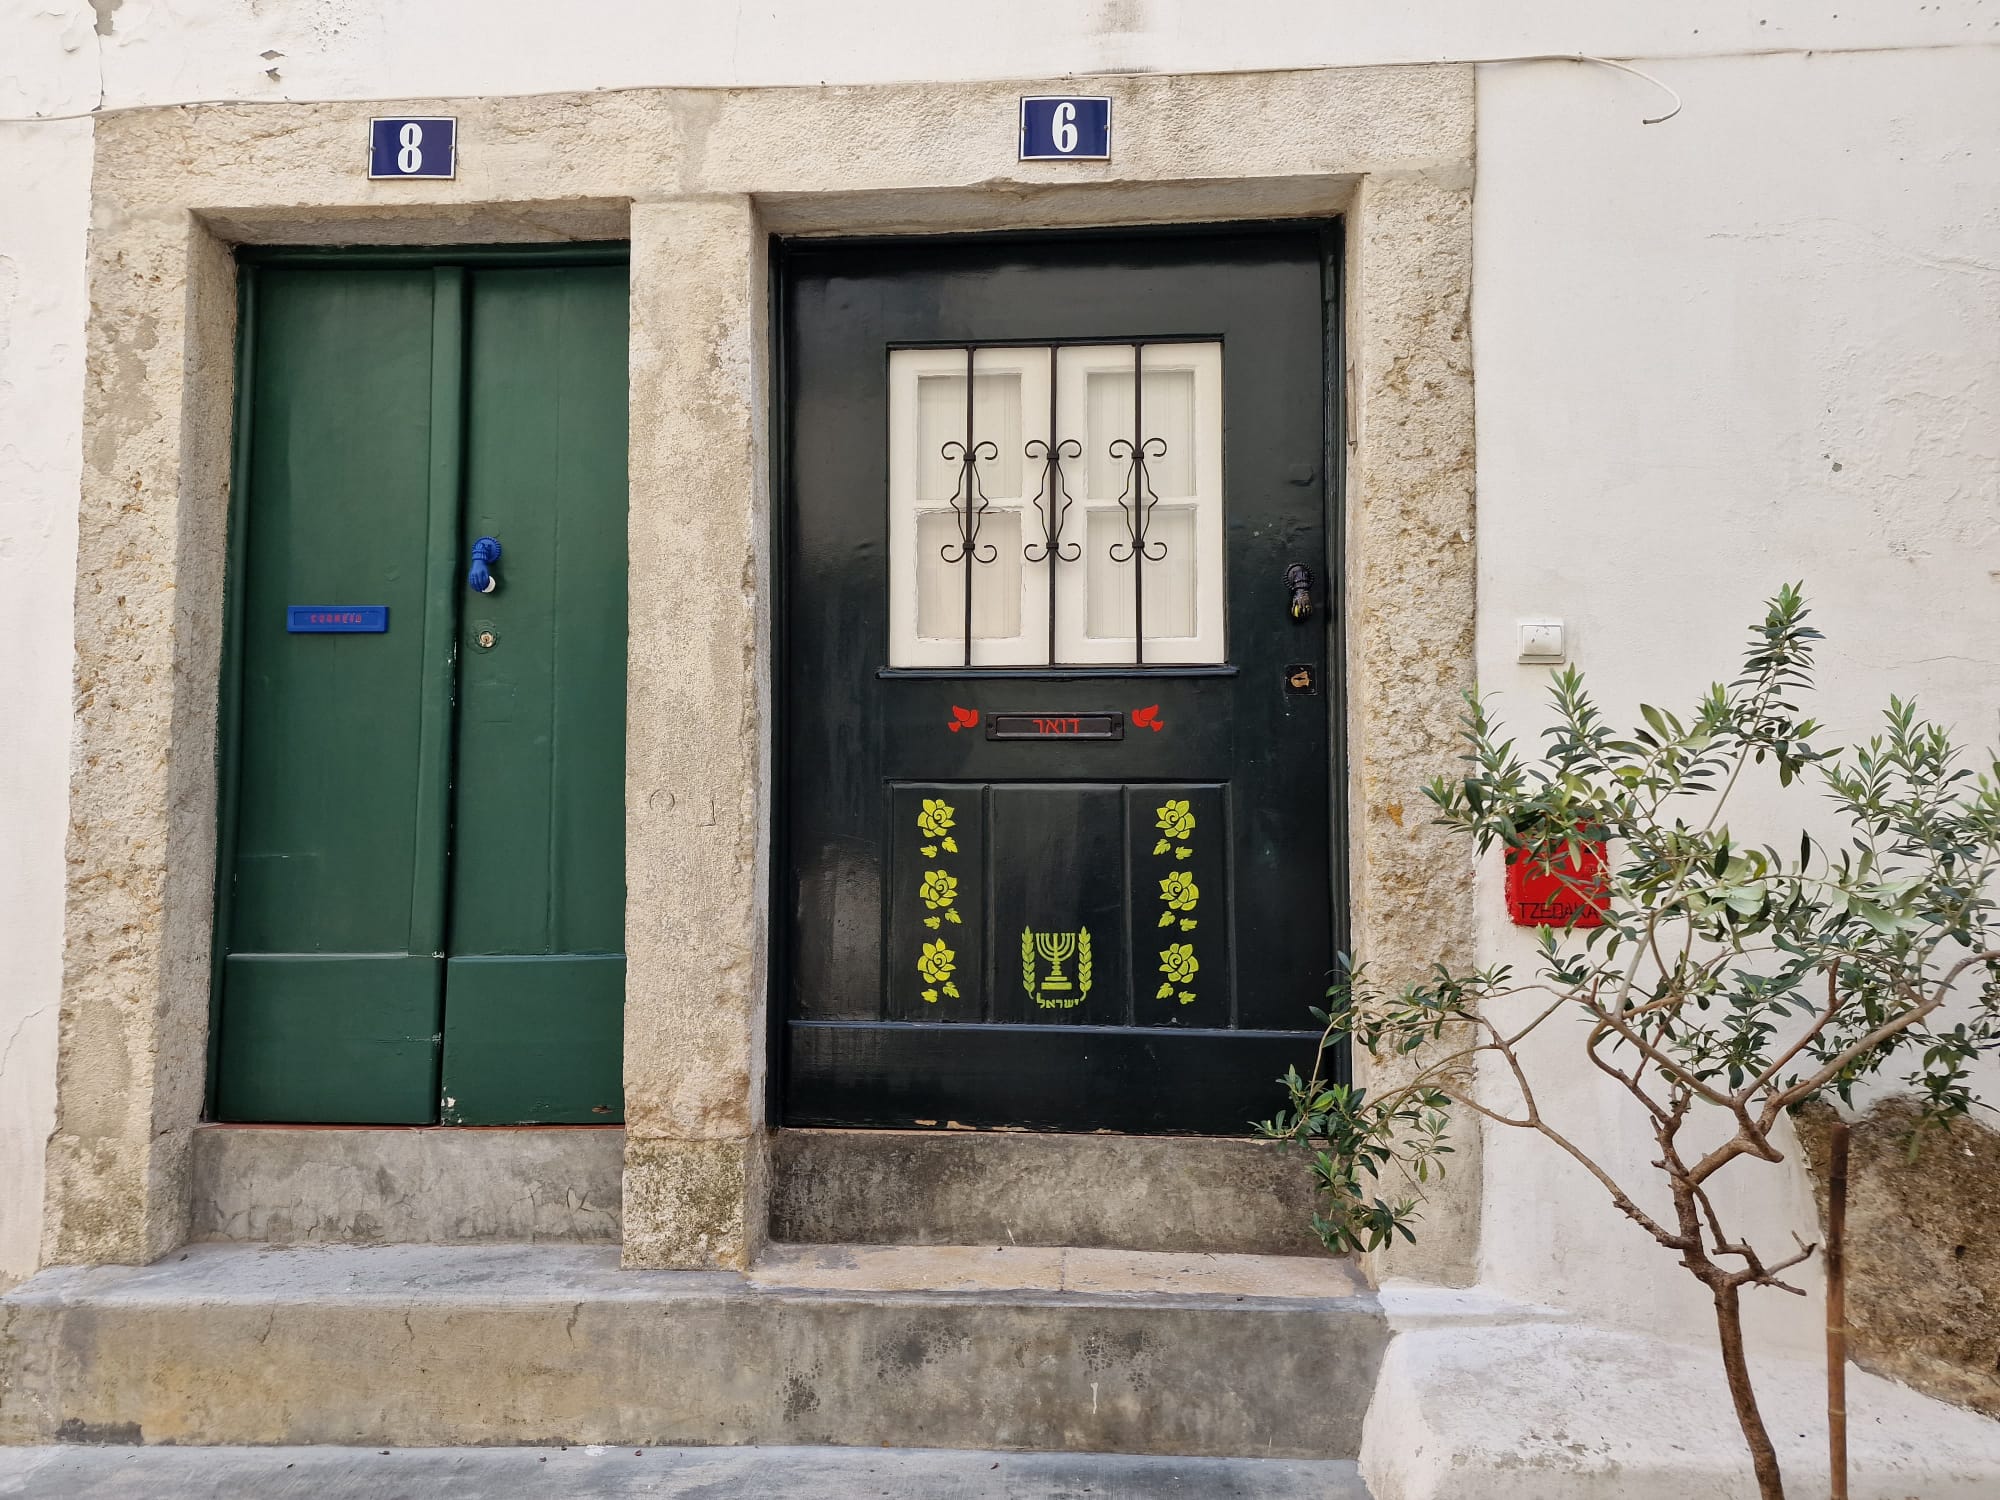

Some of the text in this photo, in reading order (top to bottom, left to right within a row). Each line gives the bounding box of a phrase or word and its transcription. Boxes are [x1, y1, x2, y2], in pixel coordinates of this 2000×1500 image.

[1053, 103, 1078, 153] 6
[398, 123, 422, 173] 8
[1033, 719, 1080, 734] דואר
[1036, 992, 1079, 1008] ישראל
